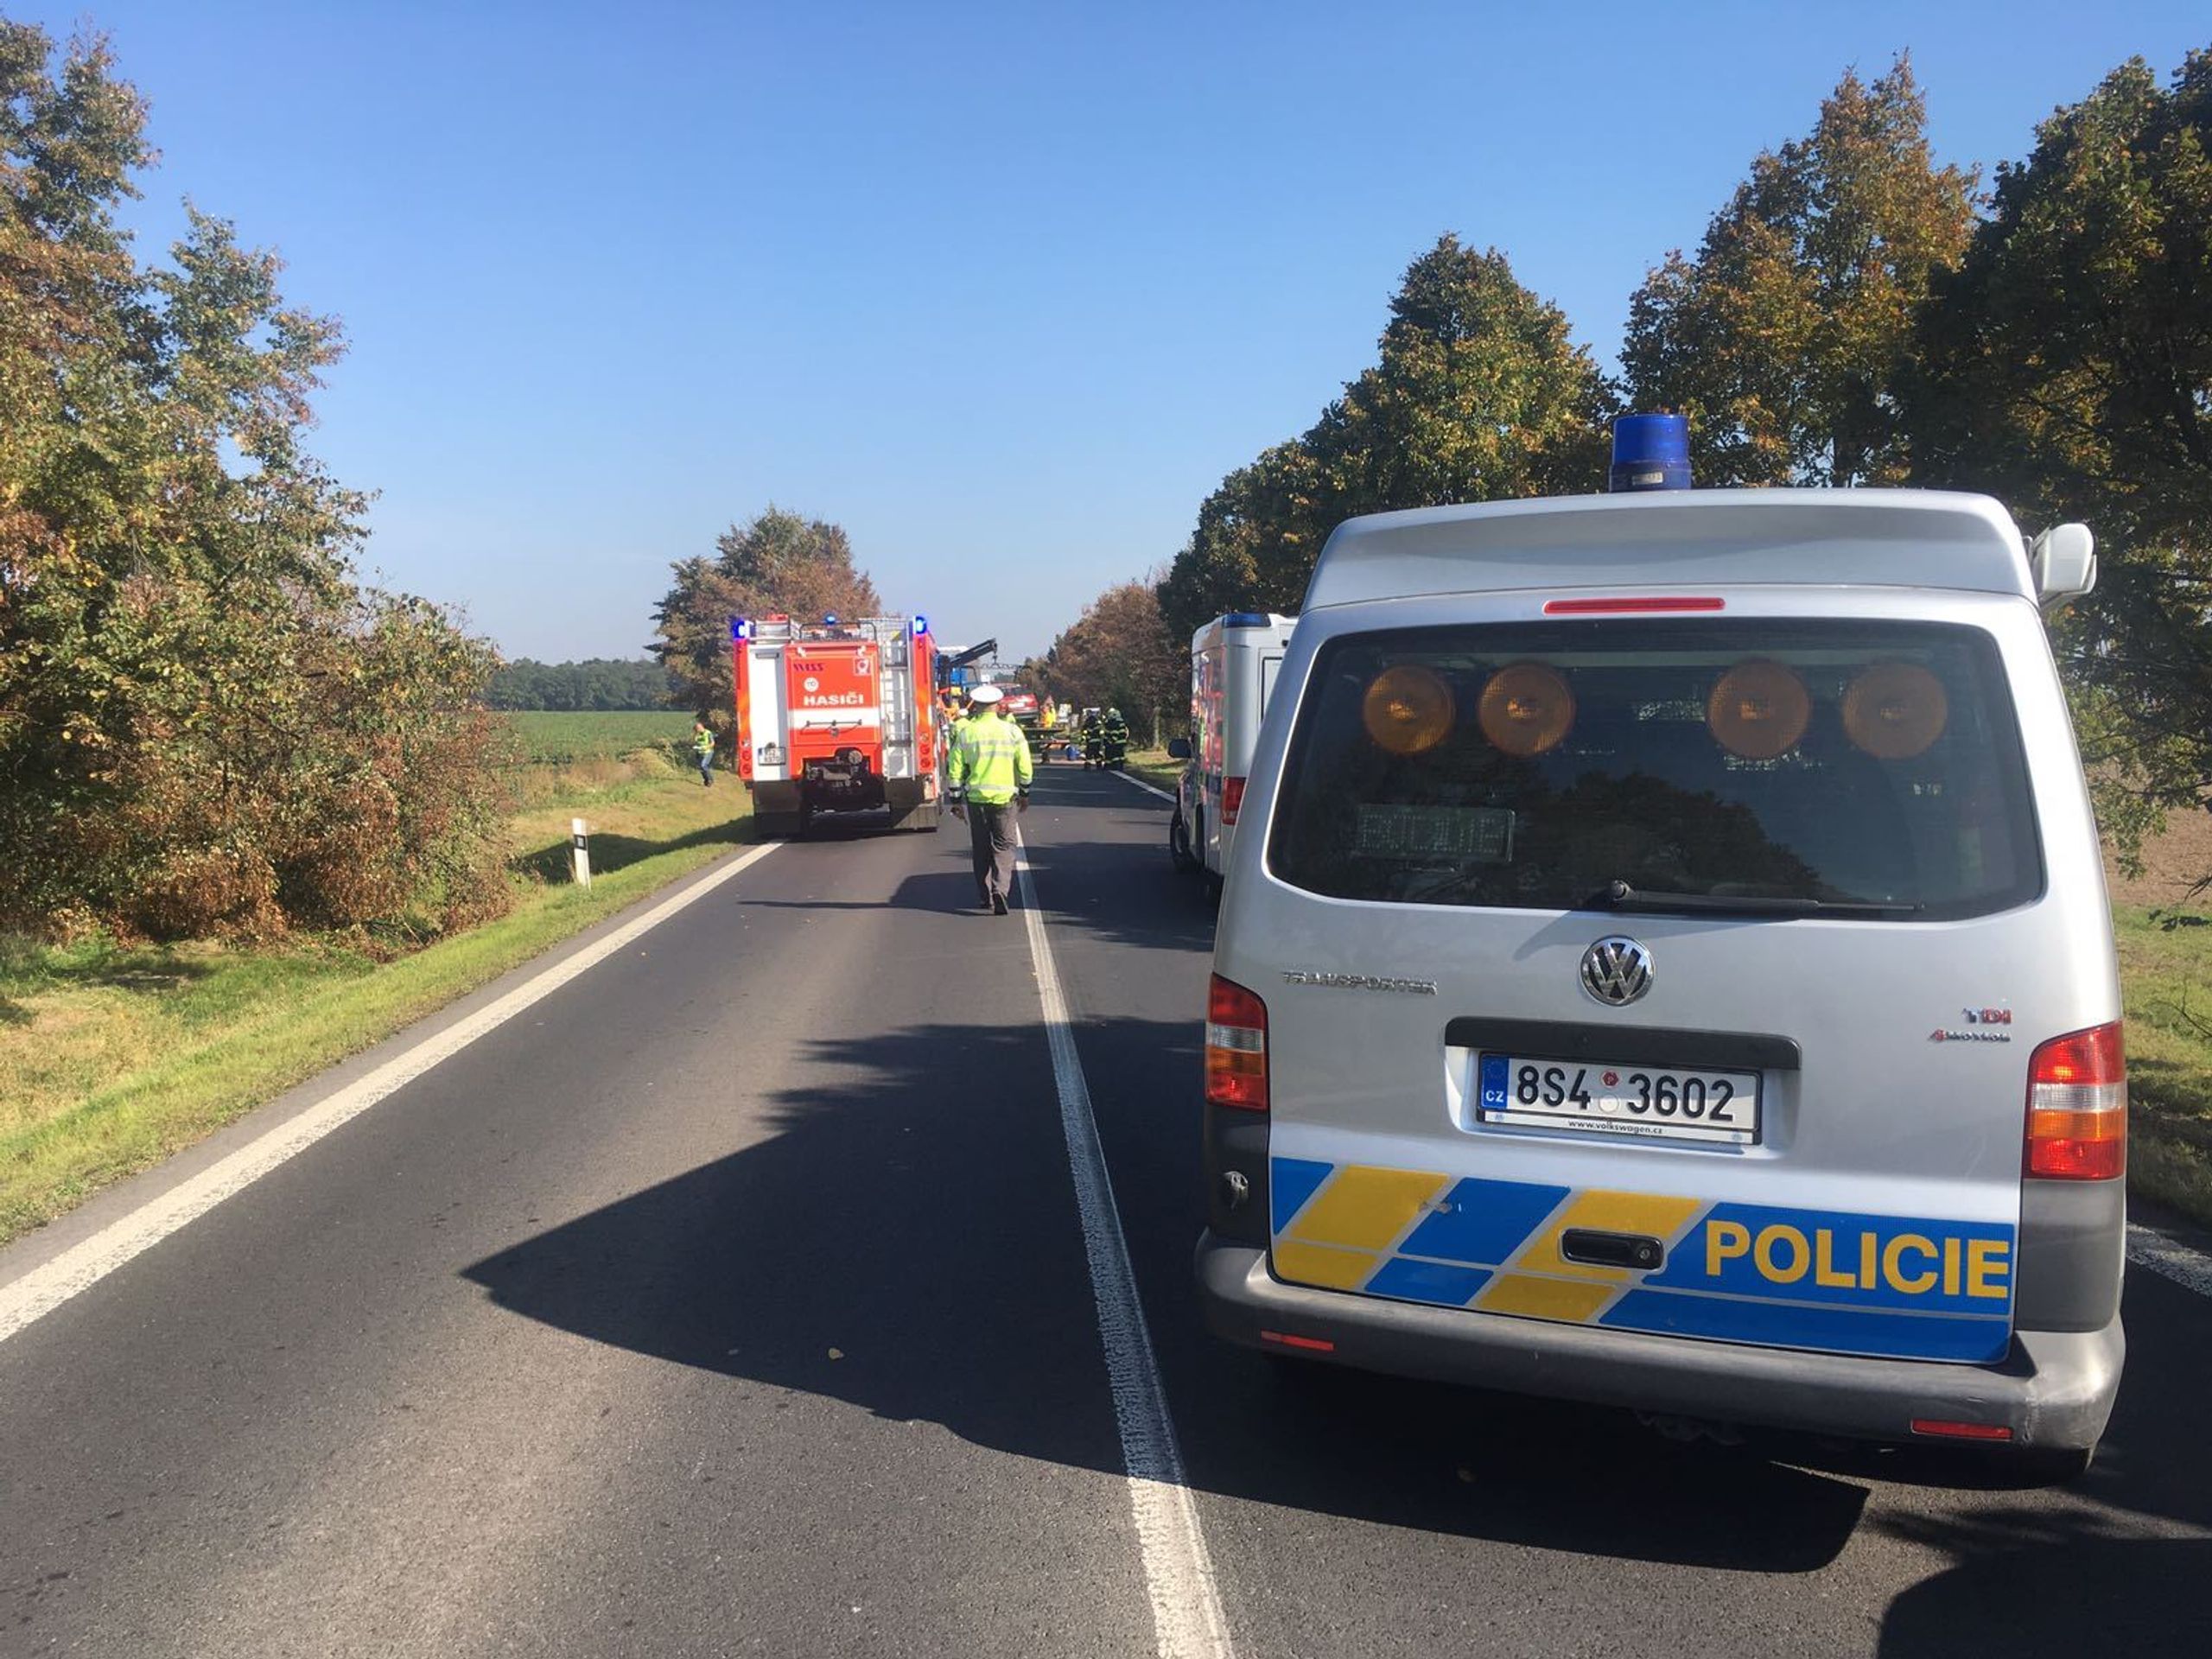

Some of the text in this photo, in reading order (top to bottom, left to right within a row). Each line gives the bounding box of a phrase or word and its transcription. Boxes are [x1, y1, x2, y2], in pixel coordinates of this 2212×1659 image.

[804, 691, 864, 706] HASIČI
[1962, 1008, 2012, 1024] TDI
[1485, 1090, 1504, 1103] CZ
[1516, 1065, 1734, 1122] 8S4 3602
[1568, 1119, 1664, 1136] www.volkswagen.cz
[1706, 1219, 2010, 1299] POLICIE
